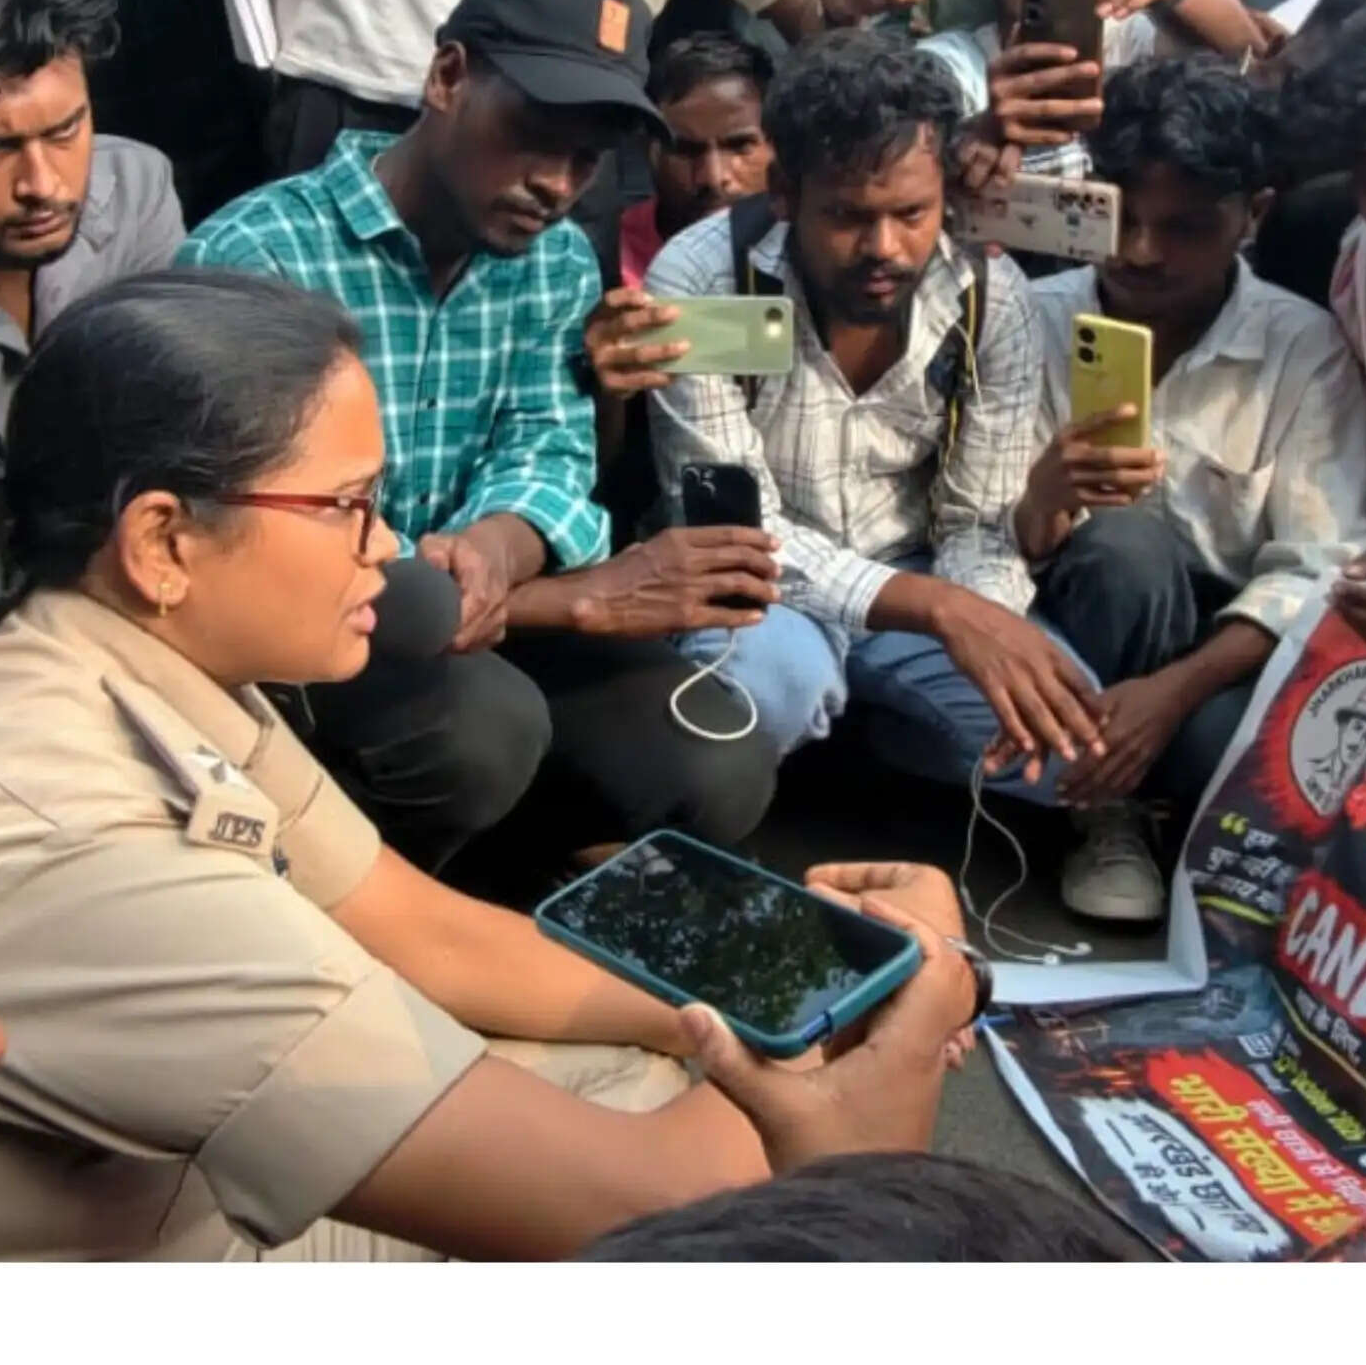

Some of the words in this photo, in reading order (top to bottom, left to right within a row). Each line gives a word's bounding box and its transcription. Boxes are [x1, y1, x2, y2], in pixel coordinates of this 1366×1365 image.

[1119, 1112, 1214, 1179] झारखंड
[1169, 1072, 1250, 1123] भारी
[1215, 1124, 1312, 1195] संख्या
[1285, 1189, 1348, 1215] में
